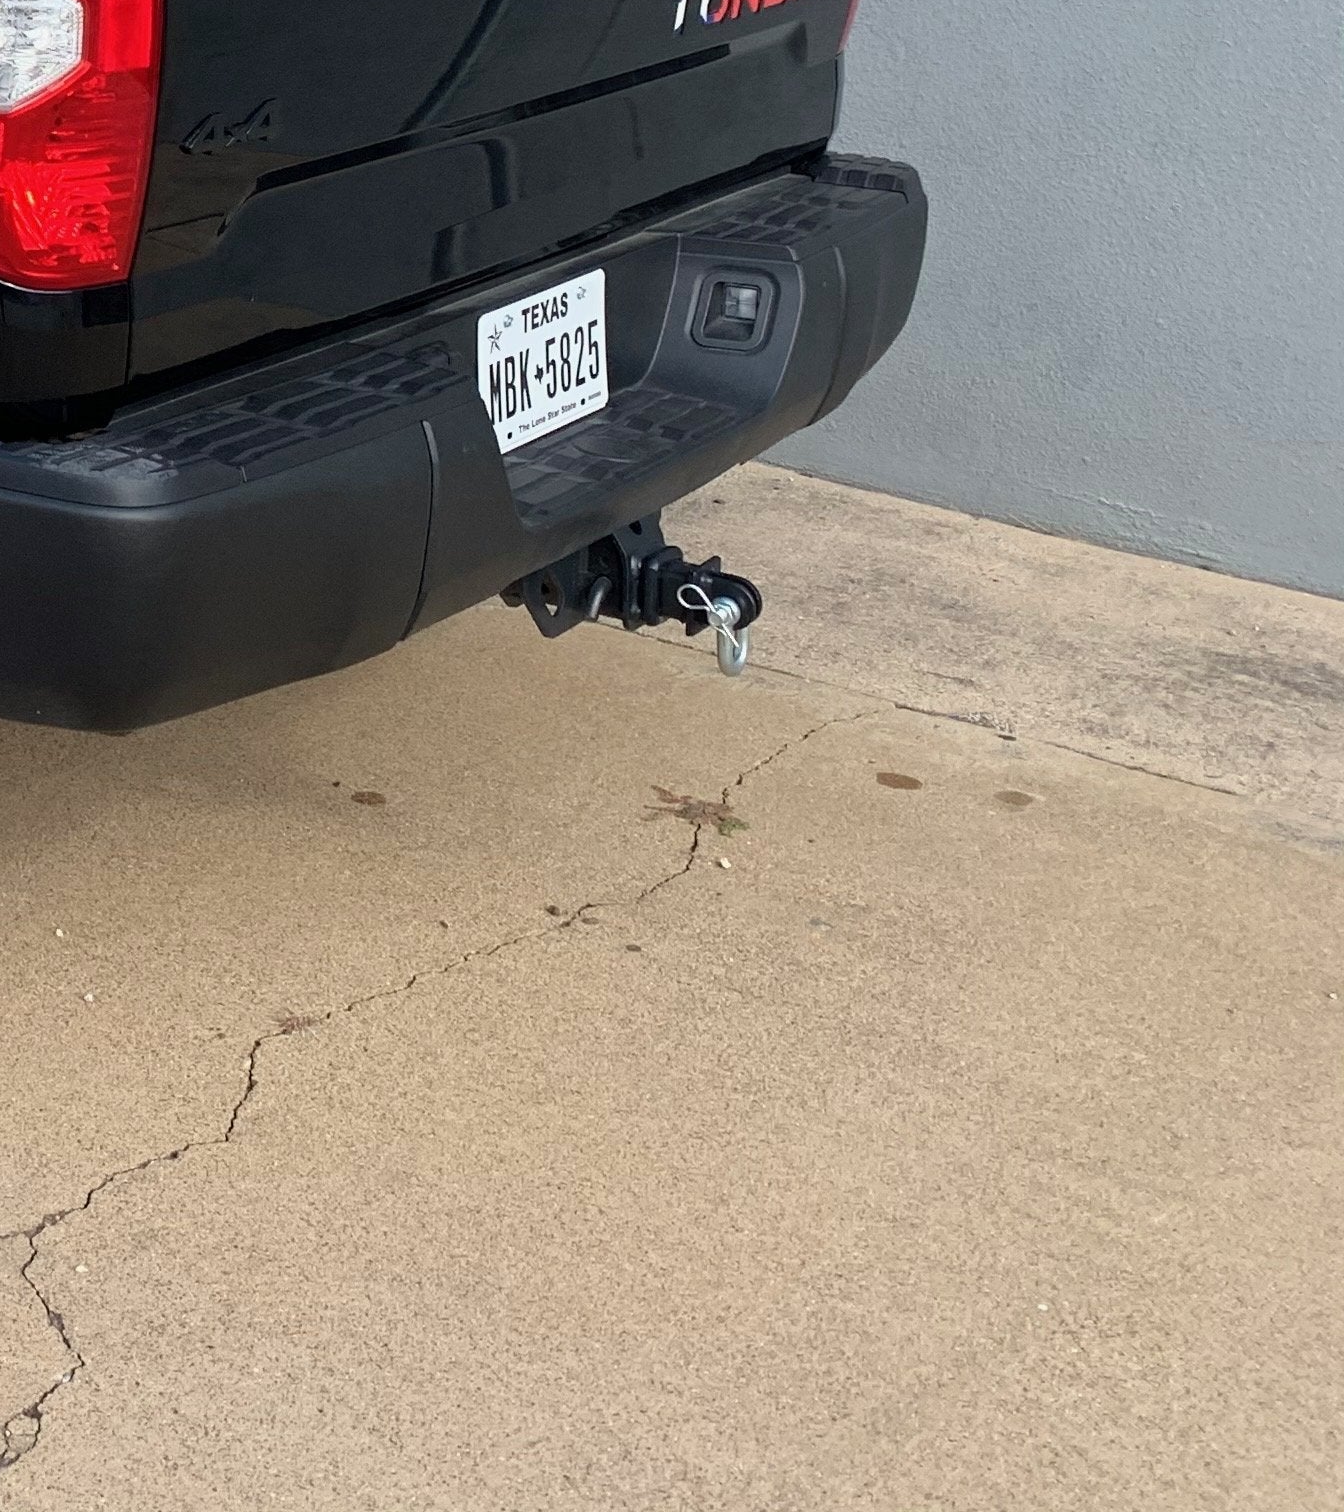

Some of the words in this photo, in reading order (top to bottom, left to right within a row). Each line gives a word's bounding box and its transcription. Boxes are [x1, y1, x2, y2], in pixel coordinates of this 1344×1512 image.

[521, 292, 569, 333] TEXAS
[518, 423, 530, 433] The
[531, 416, 546, 428] Lone
[547, 409, 560, 420] Star
[561, 402, 577, 414] State
